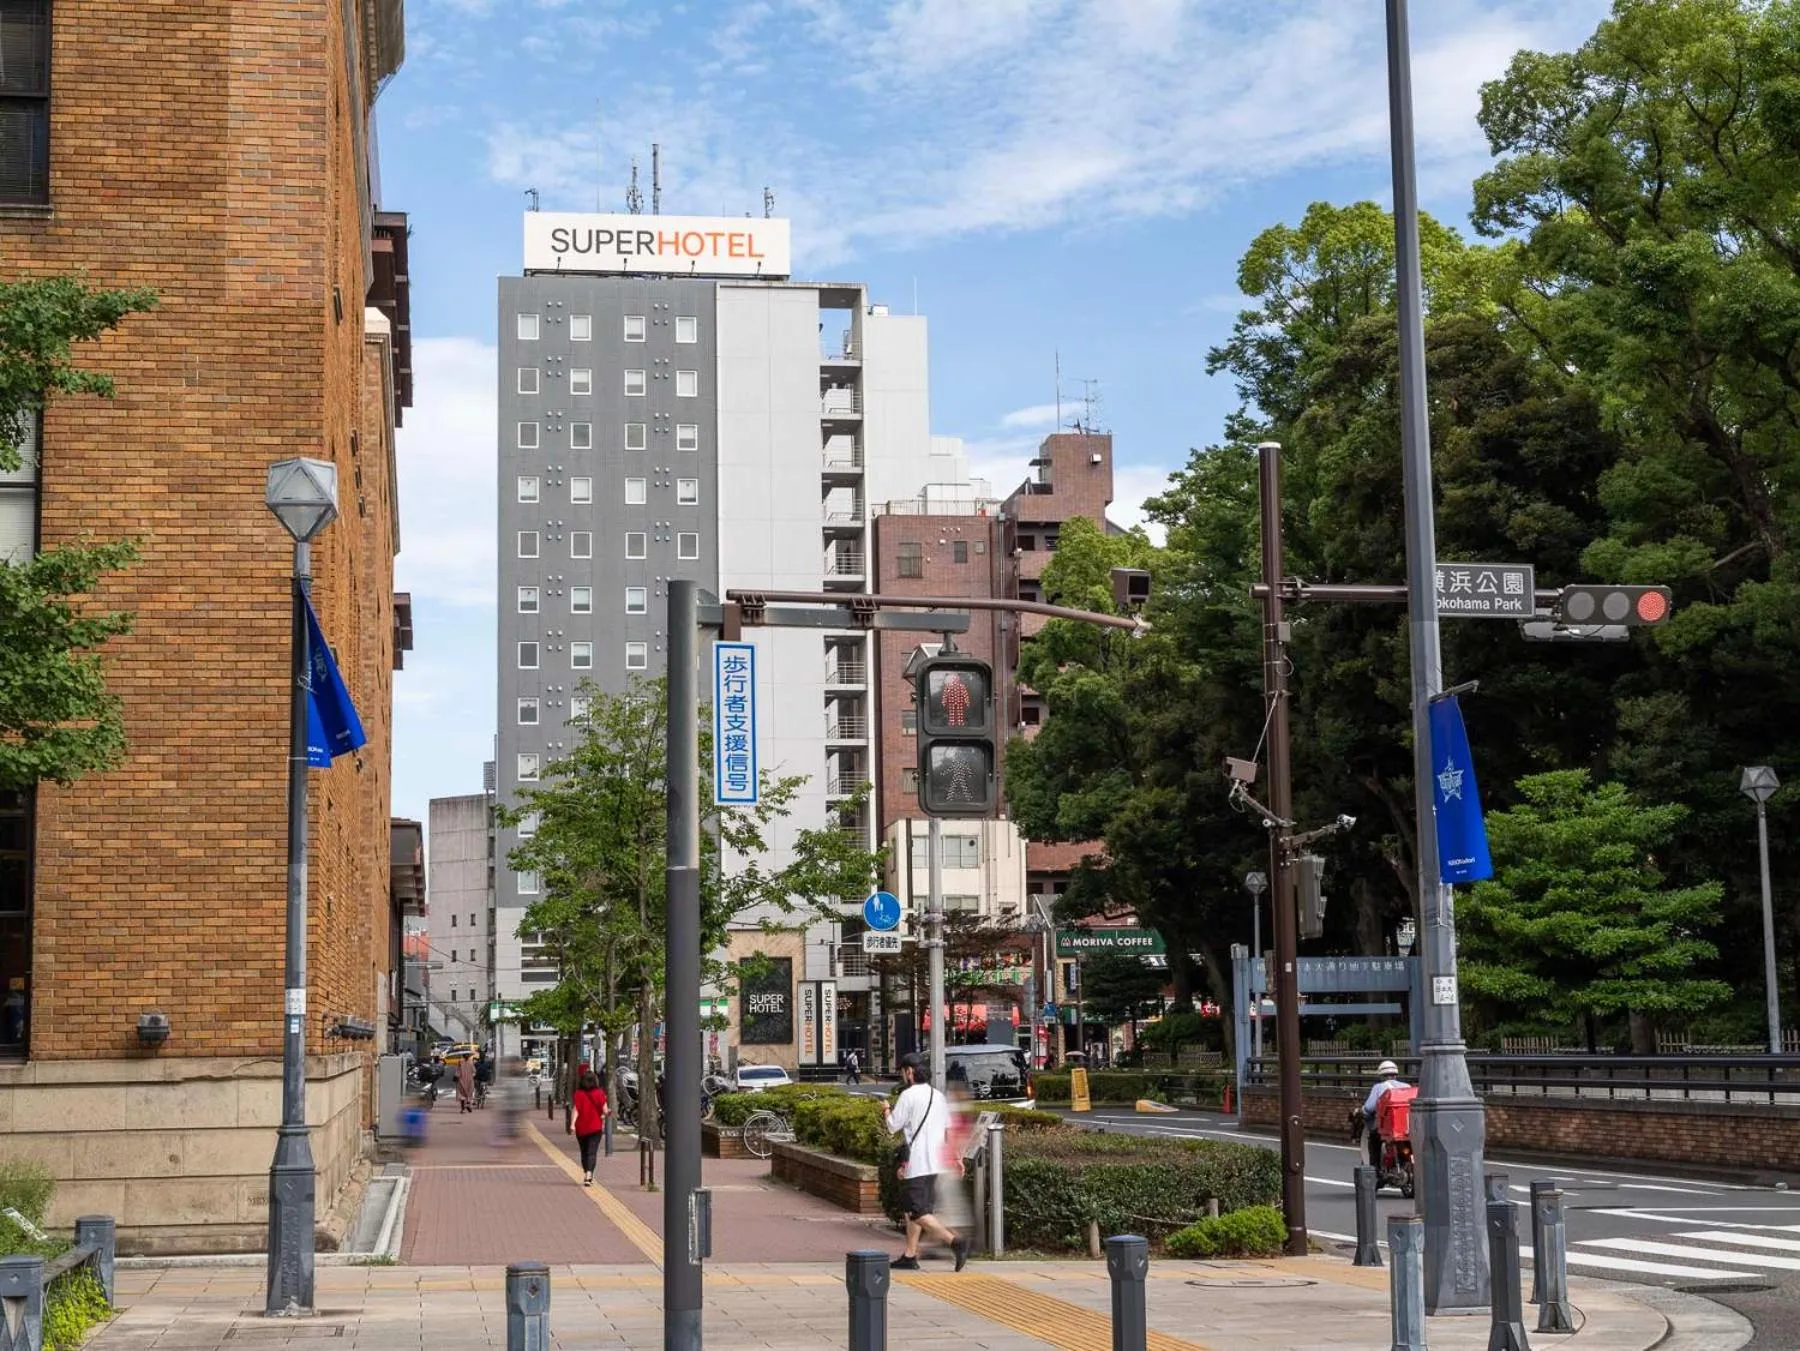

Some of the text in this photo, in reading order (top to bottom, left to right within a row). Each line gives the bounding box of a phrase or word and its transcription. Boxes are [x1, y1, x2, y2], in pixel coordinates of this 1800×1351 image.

[551, 228, 765, 258] SUPERHOTEL
[1437, 597, 1522, 611] okohama Park
[724, 656, 749, 791] 歩行者支援信号
[1073, 937, 1153, 947] MORIVA COFFEE
[749, 994, 784, 1004] SUPER
[749, 1003, 784, 1013] HOTEL
